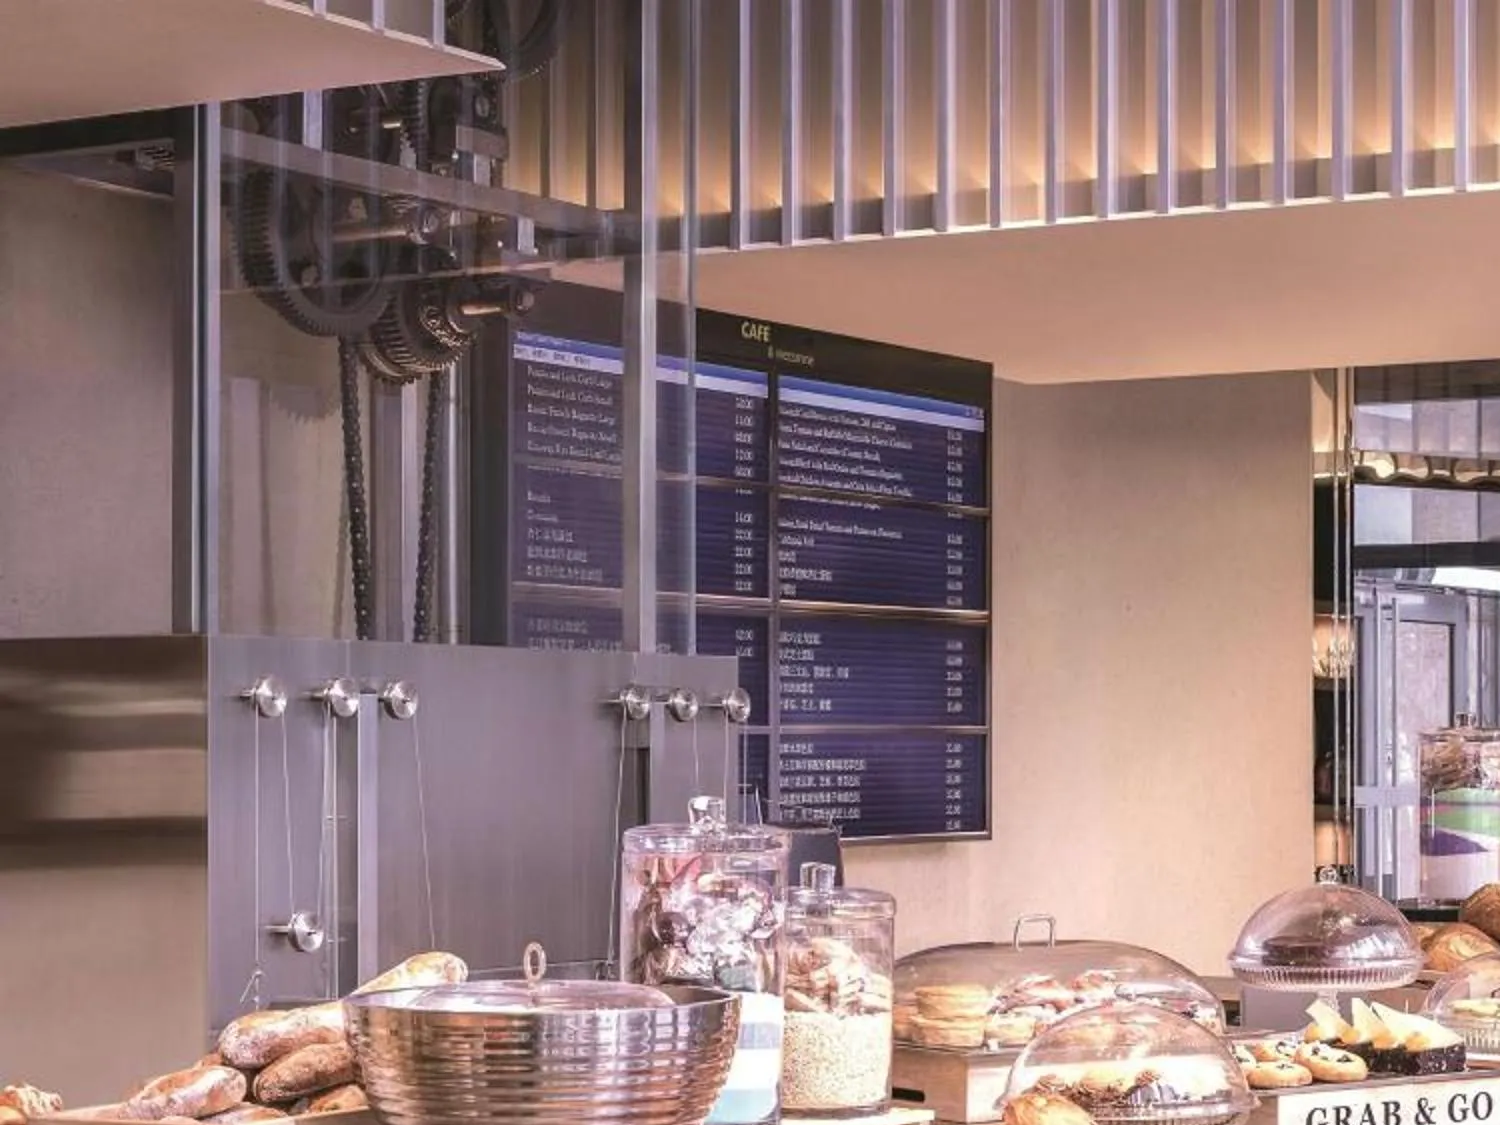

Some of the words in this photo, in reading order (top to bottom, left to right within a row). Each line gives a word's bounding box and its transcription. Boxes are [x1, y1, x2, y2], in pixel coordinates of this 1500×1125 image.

[741, 320, 770, 343] CAFE
[1414, 1097, 1437, 1125] &
[1447, 1091, 1493, 1123] GO
